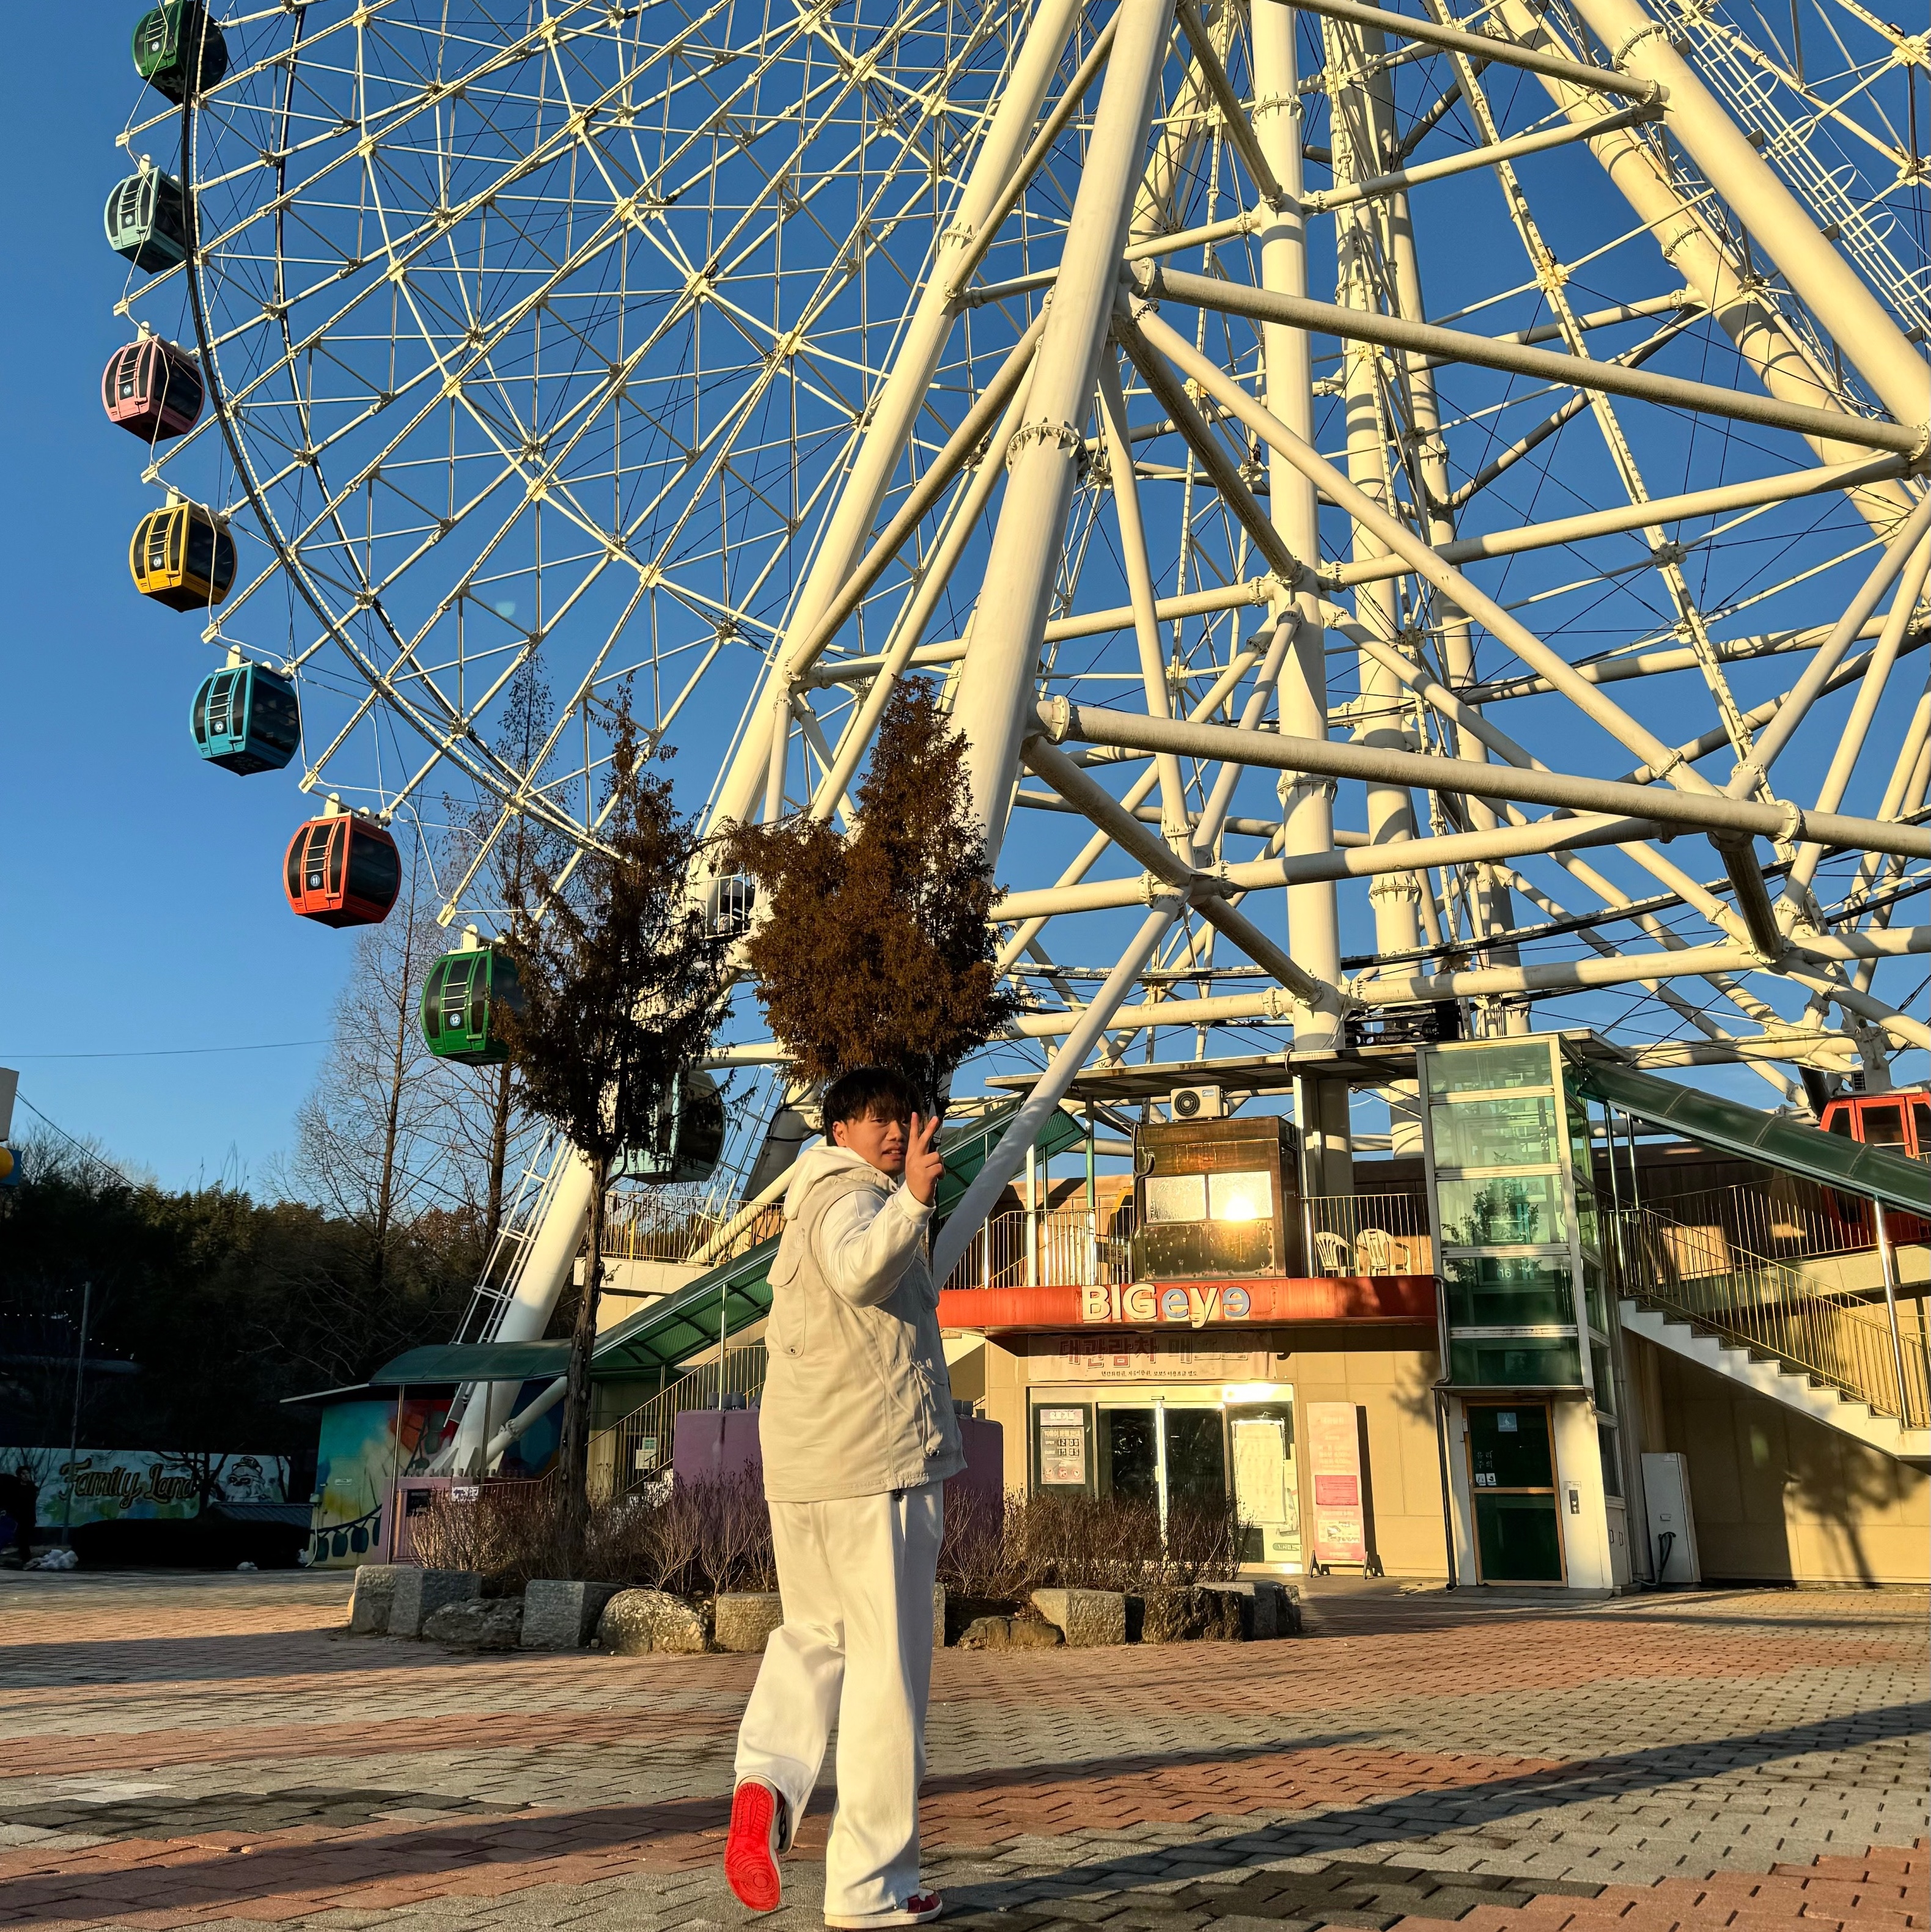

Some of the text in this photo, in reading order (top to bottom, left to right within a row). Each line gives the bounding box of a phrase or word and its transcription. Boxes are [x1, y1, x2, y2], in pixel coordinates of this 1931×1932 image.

[451, 1016, 459, 1024] 12
[1499, 1268, 1512, 1278] 16
[1059, 1337, 1159, 1368] 대관람차
[59, 1457, 142, 1510] Family
